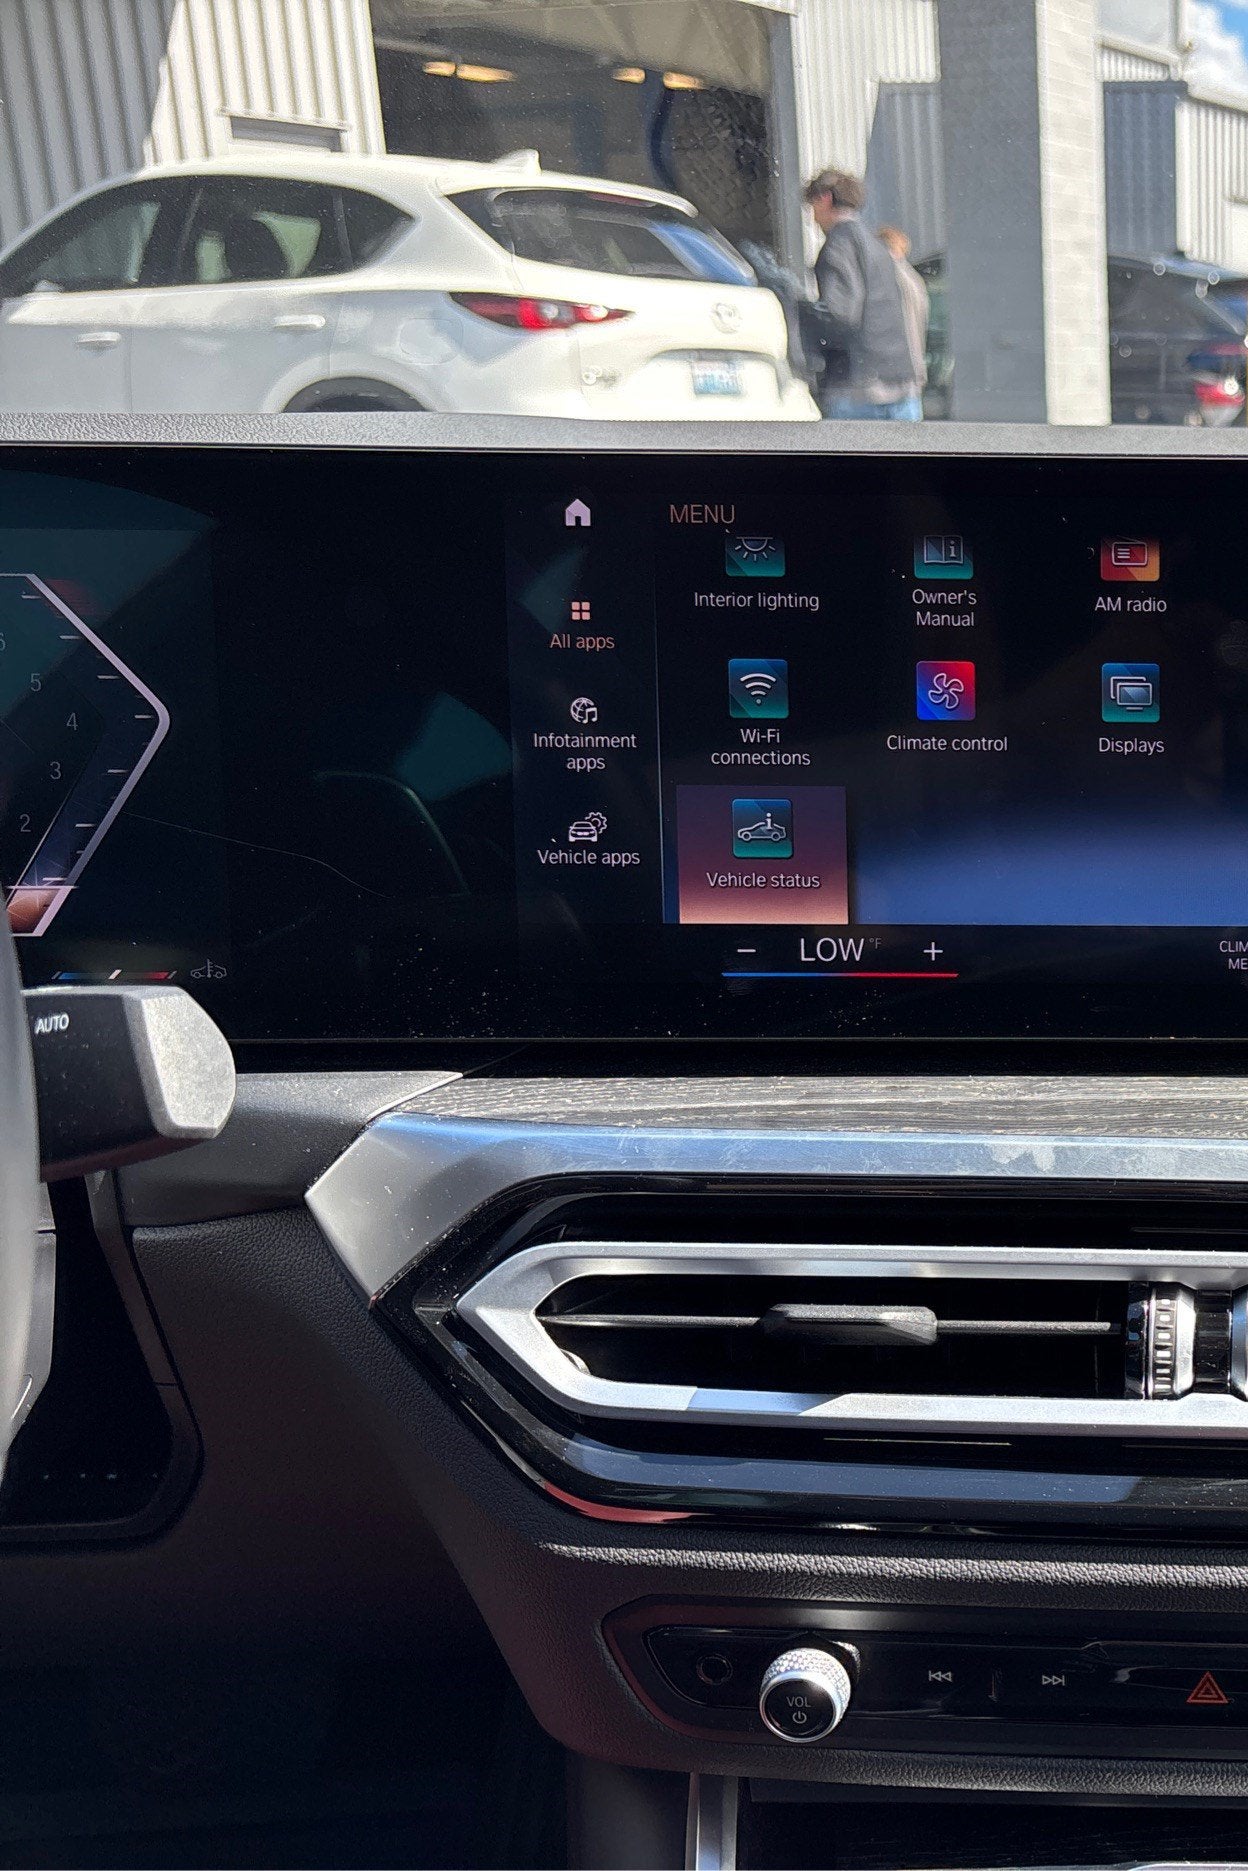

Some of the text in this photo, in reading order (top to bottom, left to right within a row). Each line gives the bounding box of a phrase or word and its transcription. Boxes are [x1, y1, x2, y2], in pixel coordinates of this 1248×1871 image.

[669, 504, 735, 524] MENU
[694, 591, 820, 612] Interior lighting
[911, 588, 977, 605] Owner's
[1094, 596, 1167, 613] AM radio
[916, 610, 975, 627] Manual
[549, 633, 615, 652] All apps
[30, 672, 42, 692] 5
[66, 712, 79, 731] 4
[534, 732, 637, 748] Infotainment
[739, 728, 780, 744] Wi-Fi
[886, 734, 1008, 752] Climate control
[1098, 737, 1165, 756] Displays
[566, 757, 606, 773] apps
[710, 750, 811, 766] connections
[49, 760, 62, 780] 3
[19, 813, 32, 833] 2
[536, 849, 641, 868] Vehicle apps
[706, 872, 821, 889] Vehicle status
[800, 937, 865, 962] LOW
[34, 1012, 70, 1034] AUTO
[786, 1696, 812, 1708] VOL
